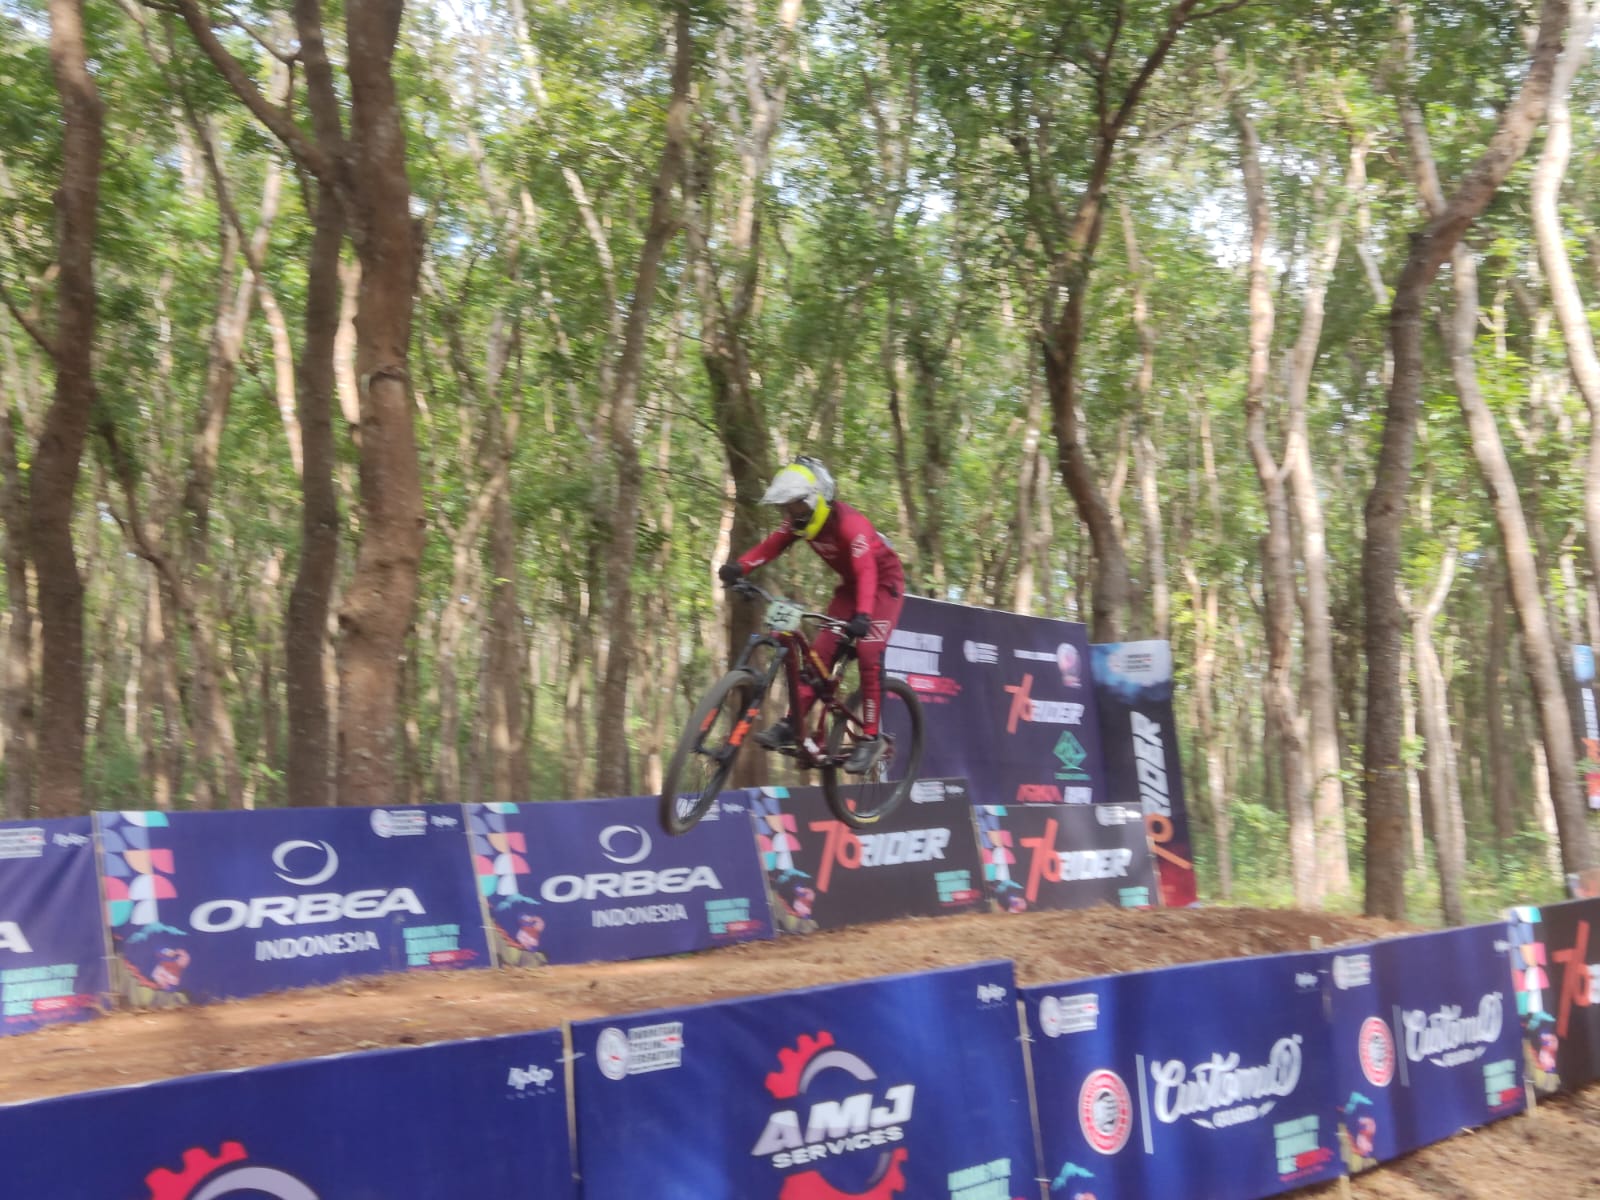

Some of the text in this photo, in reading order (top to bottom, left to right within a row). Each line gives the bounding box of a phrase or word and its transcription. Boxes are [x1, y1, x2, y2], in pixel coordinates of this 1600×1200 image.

[540, 865, 723, 903] ORBEA
[189, 887, 426, 933] ORBEA
[592, 903, 689, 928] INDONESIA
[255, 930, 380, 962] INDONESIA
[751, 1083, 916, 1157] AMJ
[771, 1126, 905, 1169] SERVICES
